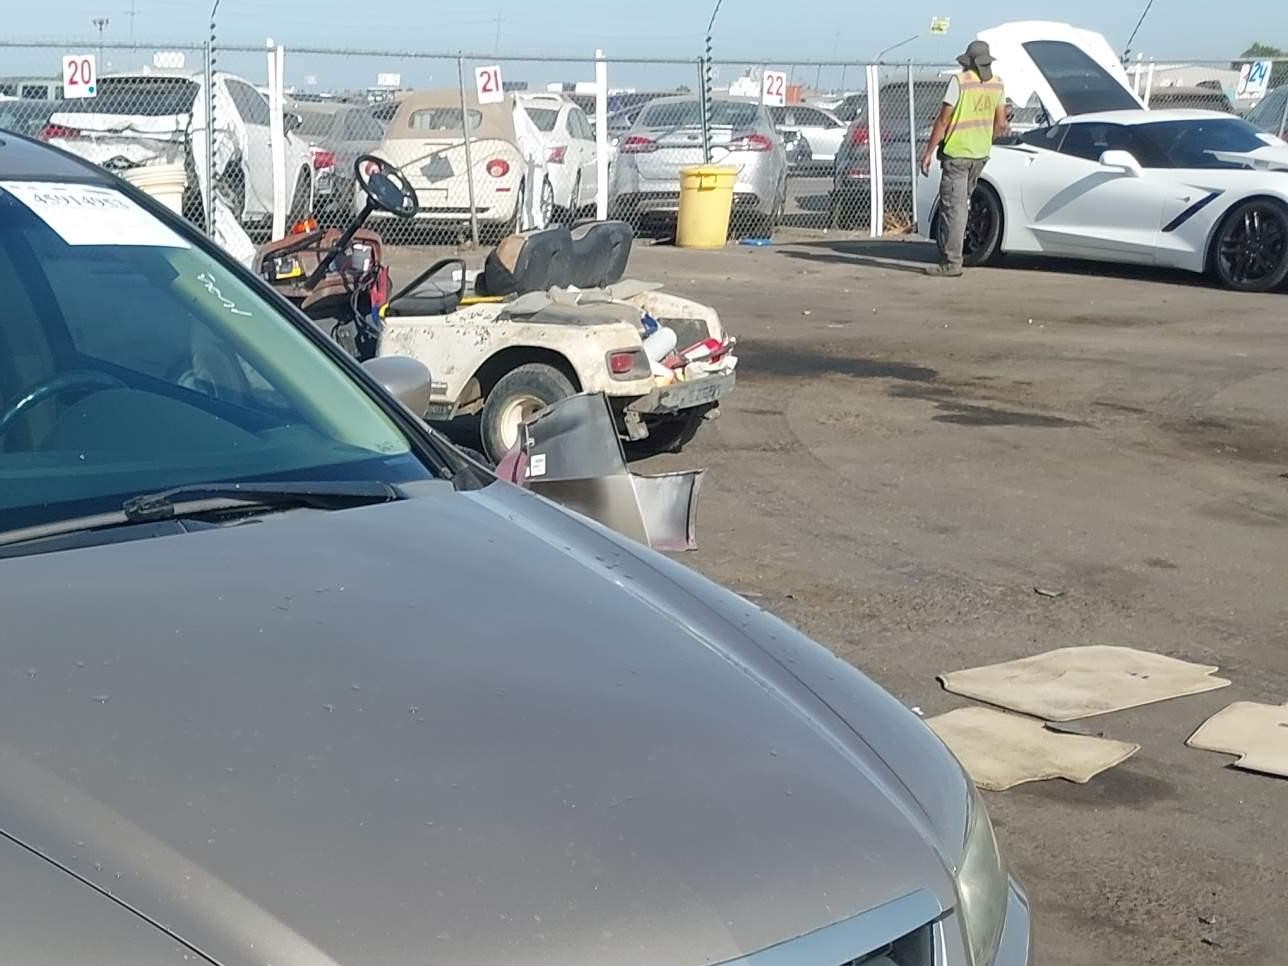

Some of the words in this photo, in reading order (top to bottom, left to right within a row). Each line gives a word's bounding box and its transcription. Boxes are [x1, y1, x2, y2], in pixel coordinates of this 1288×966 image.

[68, 59, 92, 85] 20
[479, 70, 500, 93] 21
[1248, 62, 1268, 87] 24
[766, 74, 784, 97] 22
